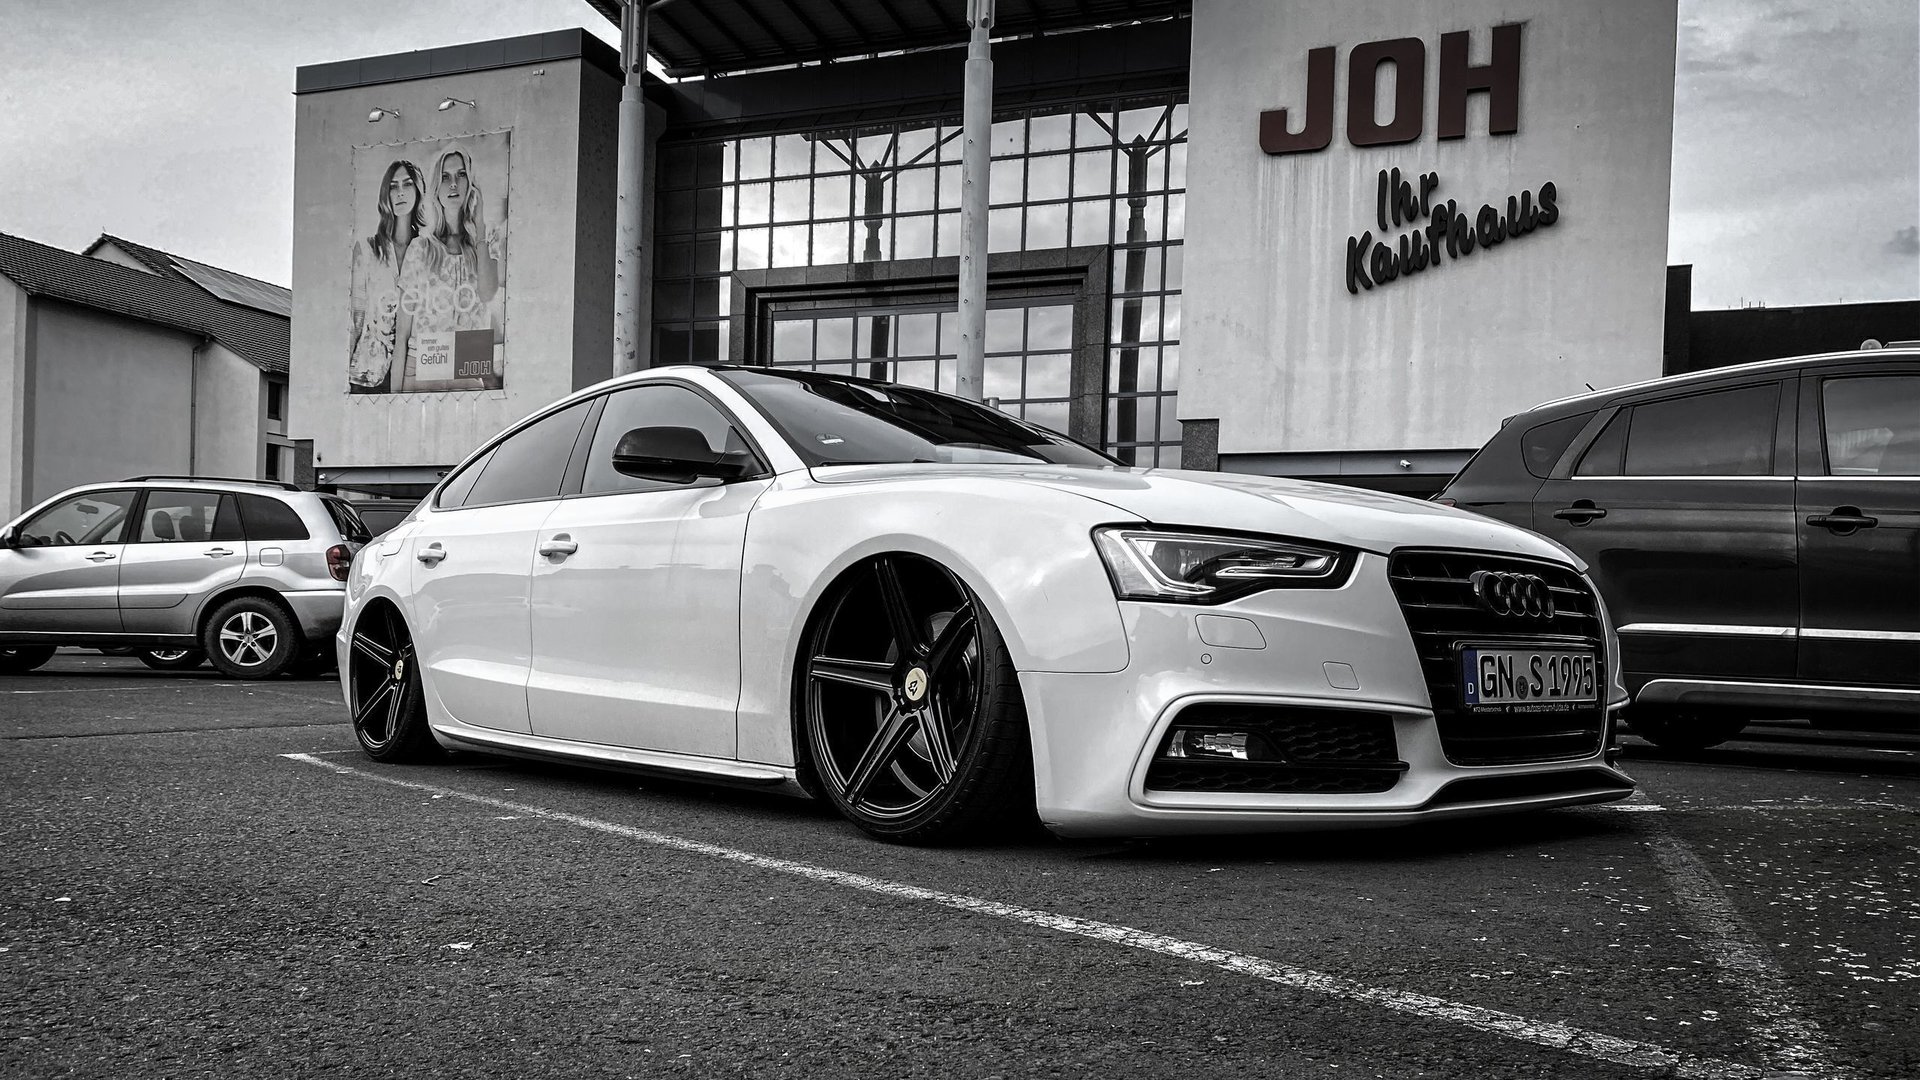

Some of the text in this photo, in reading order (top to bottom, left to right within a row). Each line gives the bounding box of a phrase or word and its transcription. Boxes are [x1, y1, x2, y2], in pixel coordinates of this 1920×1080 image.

[1259, 23, 1522, 156] JOH
[1376, 166, 1439, 232] Ihr
[1346, 181, 1559, 294] Kaufhaus
[420, 352, 448, 365] Gefühl
[458, 360, 491, 376] JOH
[1468, 682, 1474, 695] D
[1479, 654, 1593, 698] GN S 1995
